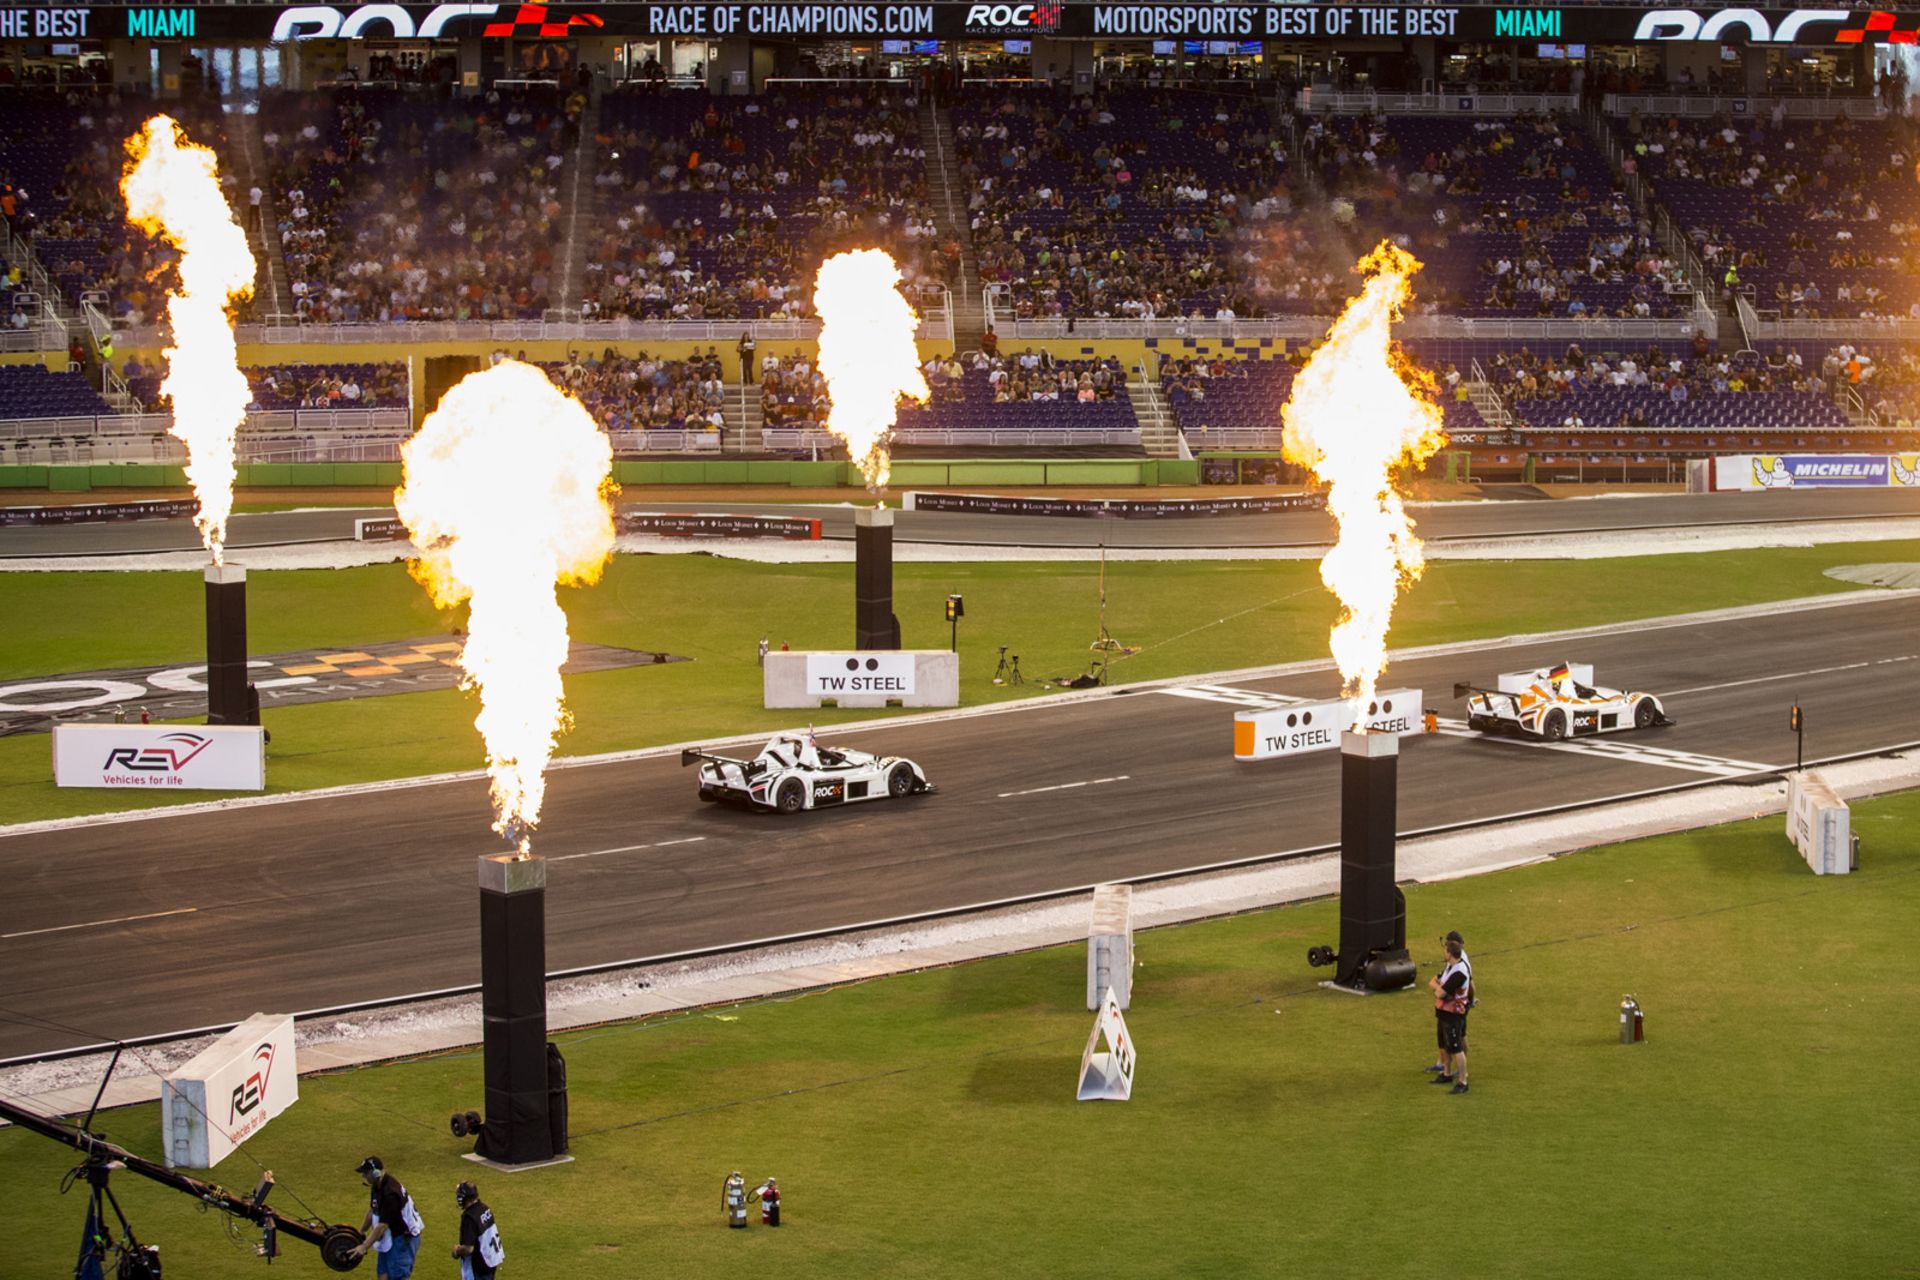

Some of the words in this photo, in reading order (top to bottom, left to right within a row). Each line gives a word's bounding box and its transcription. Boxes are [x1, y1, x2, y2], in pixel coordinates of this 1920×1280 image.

[0, 9, 29, 37] HE
[35, 9, 91, 37] BEST
[127, 8, 196, 38] MIAMI
[649, 6, 707, 34] RACE
[713, 6, 741, 34] OF
[748, 5, 933, 33] CHAMPIONS.COM
[965, 4, 1035, 26] ROC
[1265, 7, 1320, 35] BEST
[1325, 7, 1353, 35] OF
[1358, 8, 1399, 35] THE
[1405, 8, 1459, 36] BEST
[1494, 8, 1562, 38] MIAMI
[1795, 463, 1886, 476] MICHELIN
[0, 660, 318, 712] OC
[819, 676, 846, 690] TW
[851, 676, 906, 691] STEEL
[1574, 716, 1590, 727] ROC
[103, 738, 214, 771] REV
[1265, 735, 1287, 752] TW
[1291, 729, 1332, 749] STEEL
[103, 775, 146, 785] Vehicles
[149, 775, 164, 785] for
[167, 775, 184, 785] life
[814, 785, 834, 798] ROC
[229, 1043, 277, 1126] REV
